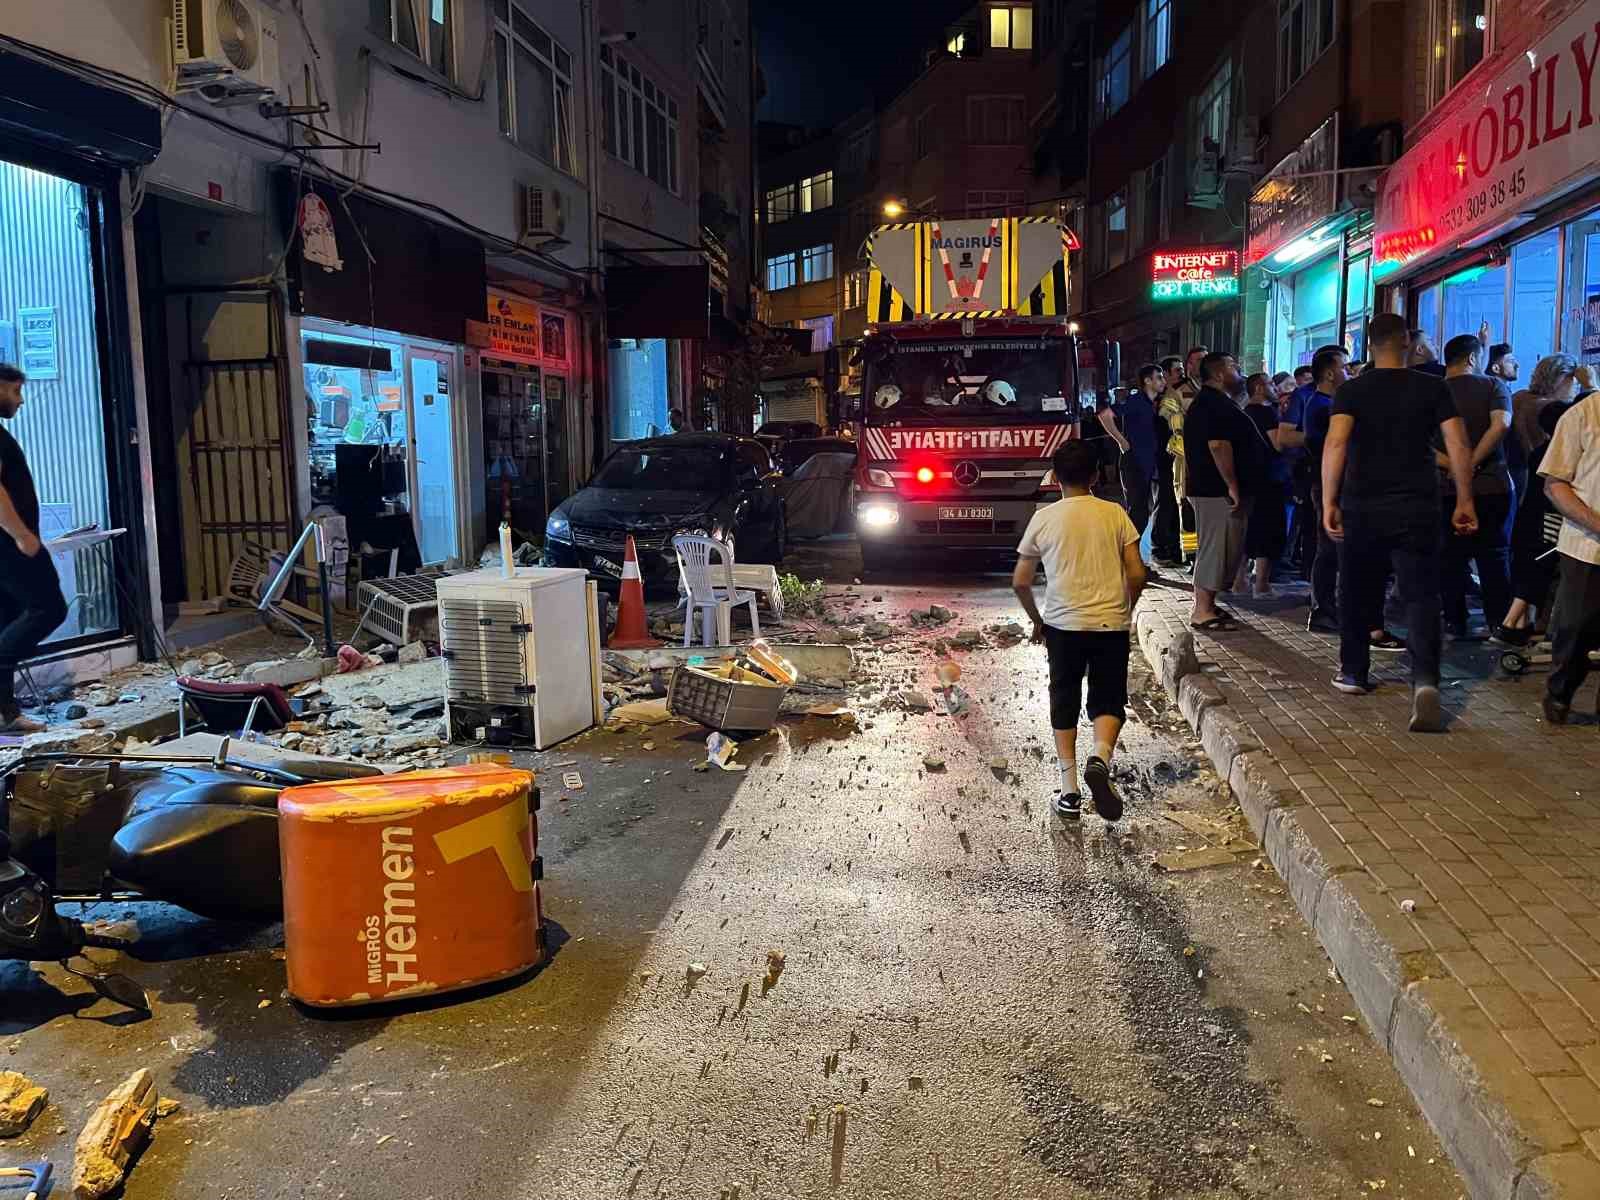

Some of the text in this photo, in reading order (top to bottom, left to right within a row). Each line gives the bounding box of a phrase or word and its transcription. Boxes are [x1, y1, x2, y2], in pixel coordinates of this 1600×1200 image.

[1466, 196, 1487, 222] 309
[1489, 179, 1505, 209] 38
[1509, 167, 1526, 198] 45
[930, 235, 1003, 249] MAGIRUS
[381, 825, 418, 988] Hemen
